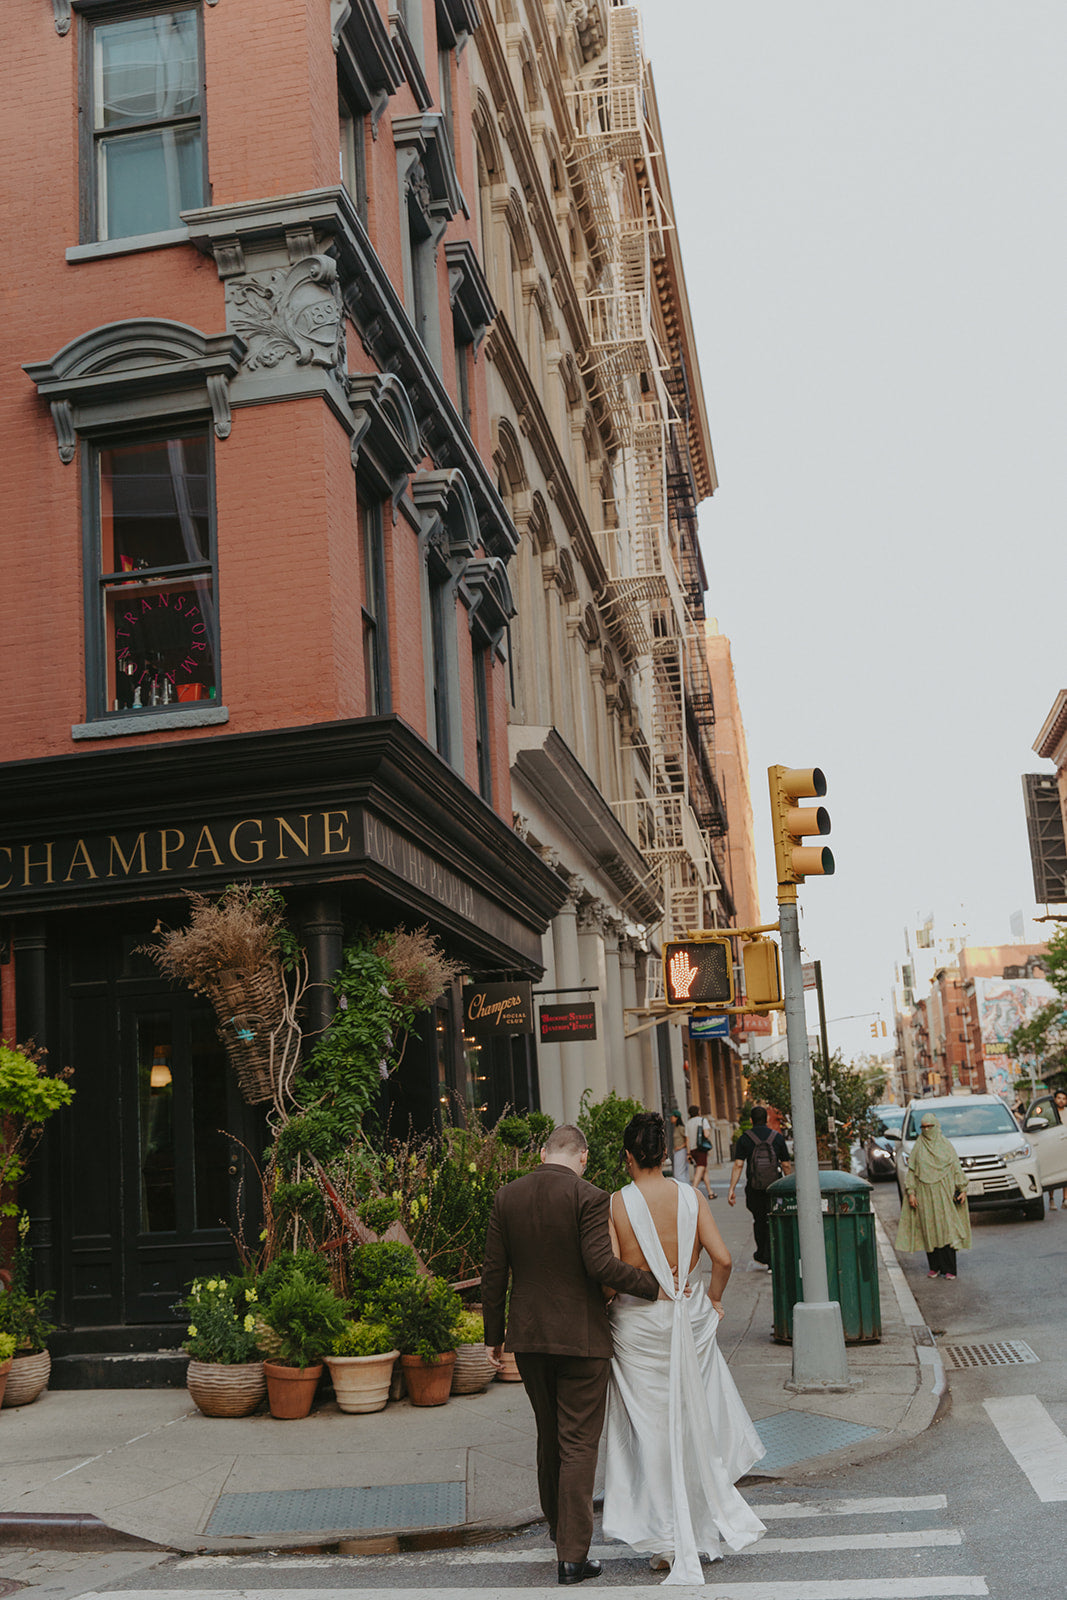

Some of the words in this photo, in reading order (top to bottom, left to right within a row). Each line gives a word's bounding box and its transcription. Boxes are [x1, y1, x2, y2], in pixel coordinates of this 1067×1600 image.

[366, 811, 396, 869] FOR
[399, 836, 427, 889] THE
[468, 993, 521, 1026] Champers
